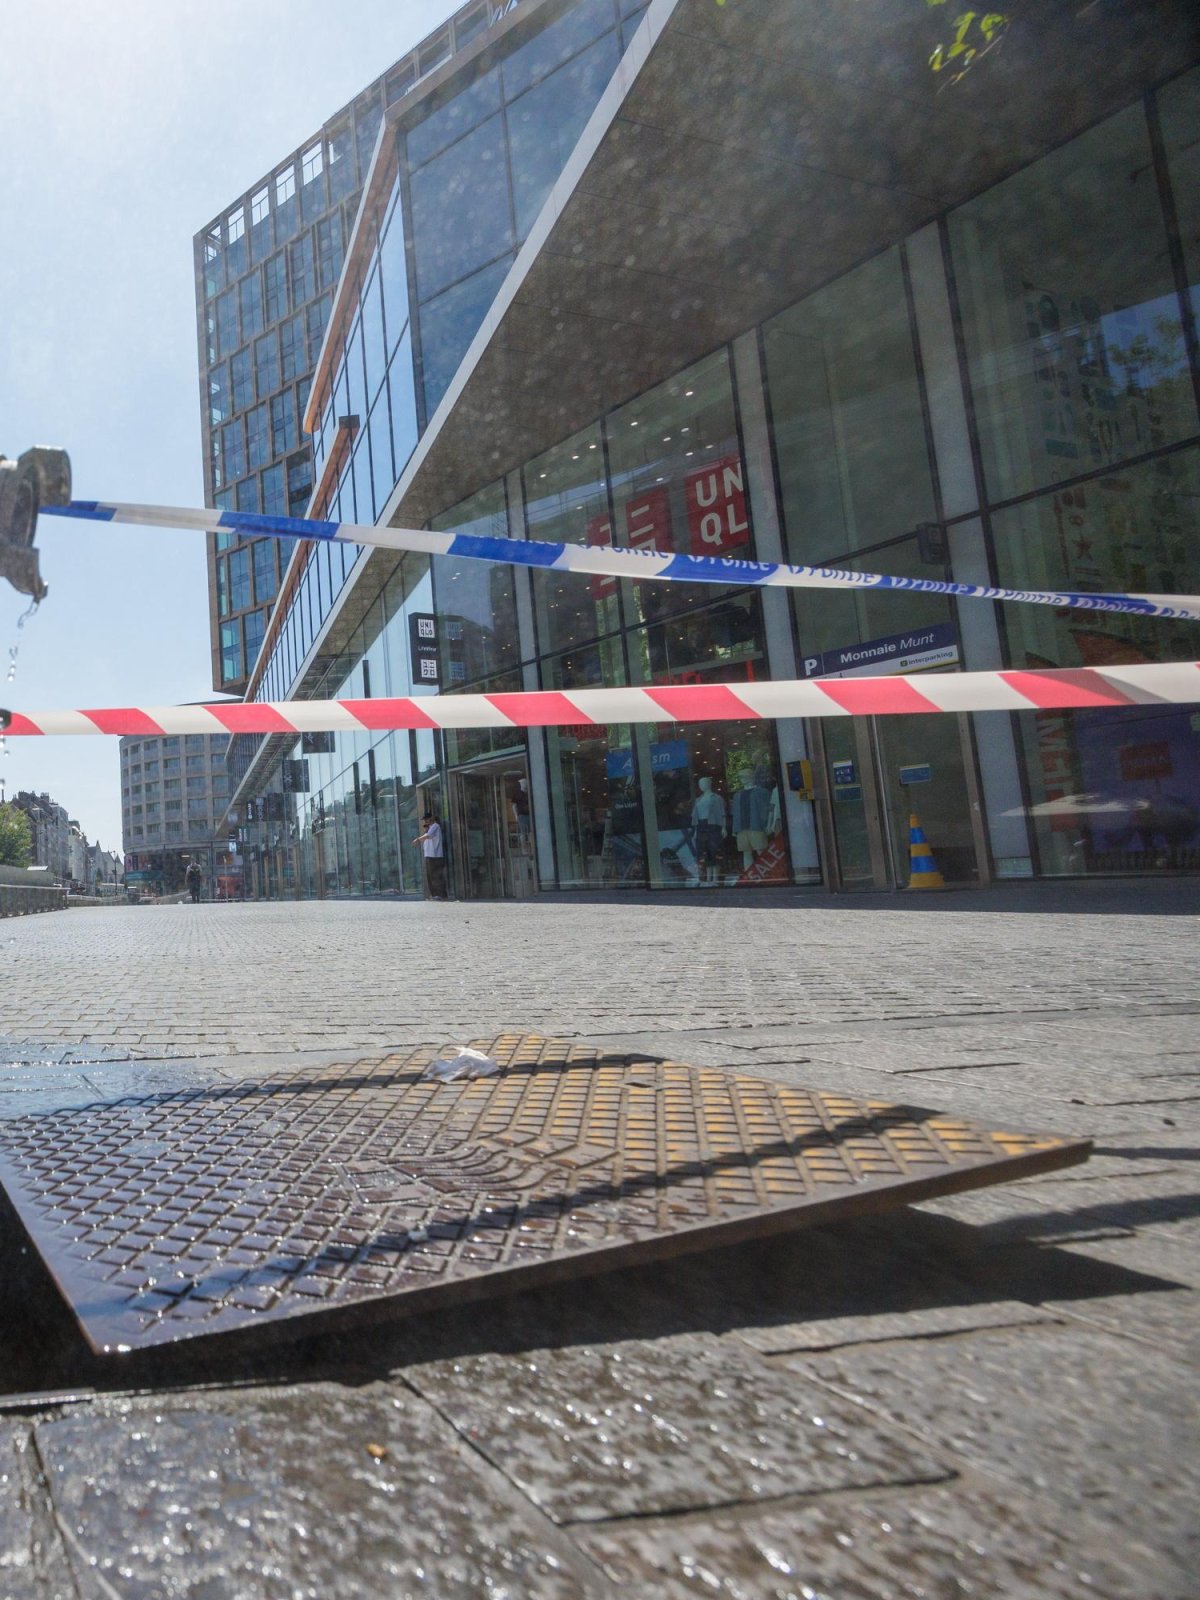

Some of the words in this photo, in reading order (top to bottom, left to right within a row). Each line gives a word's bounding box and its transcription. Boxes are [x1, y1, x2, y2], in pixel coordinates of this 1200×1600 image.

[695, 462, 744, 507] UN
[701, 503, 748, 546] QL
[804, 659, 818, 676] P
[840, 643, 896, 664] Monnaie
[900, 632, 935, 650] Munt
[908, 650, 953, 666] interparking
[747, 843, 785, 884] SALE
